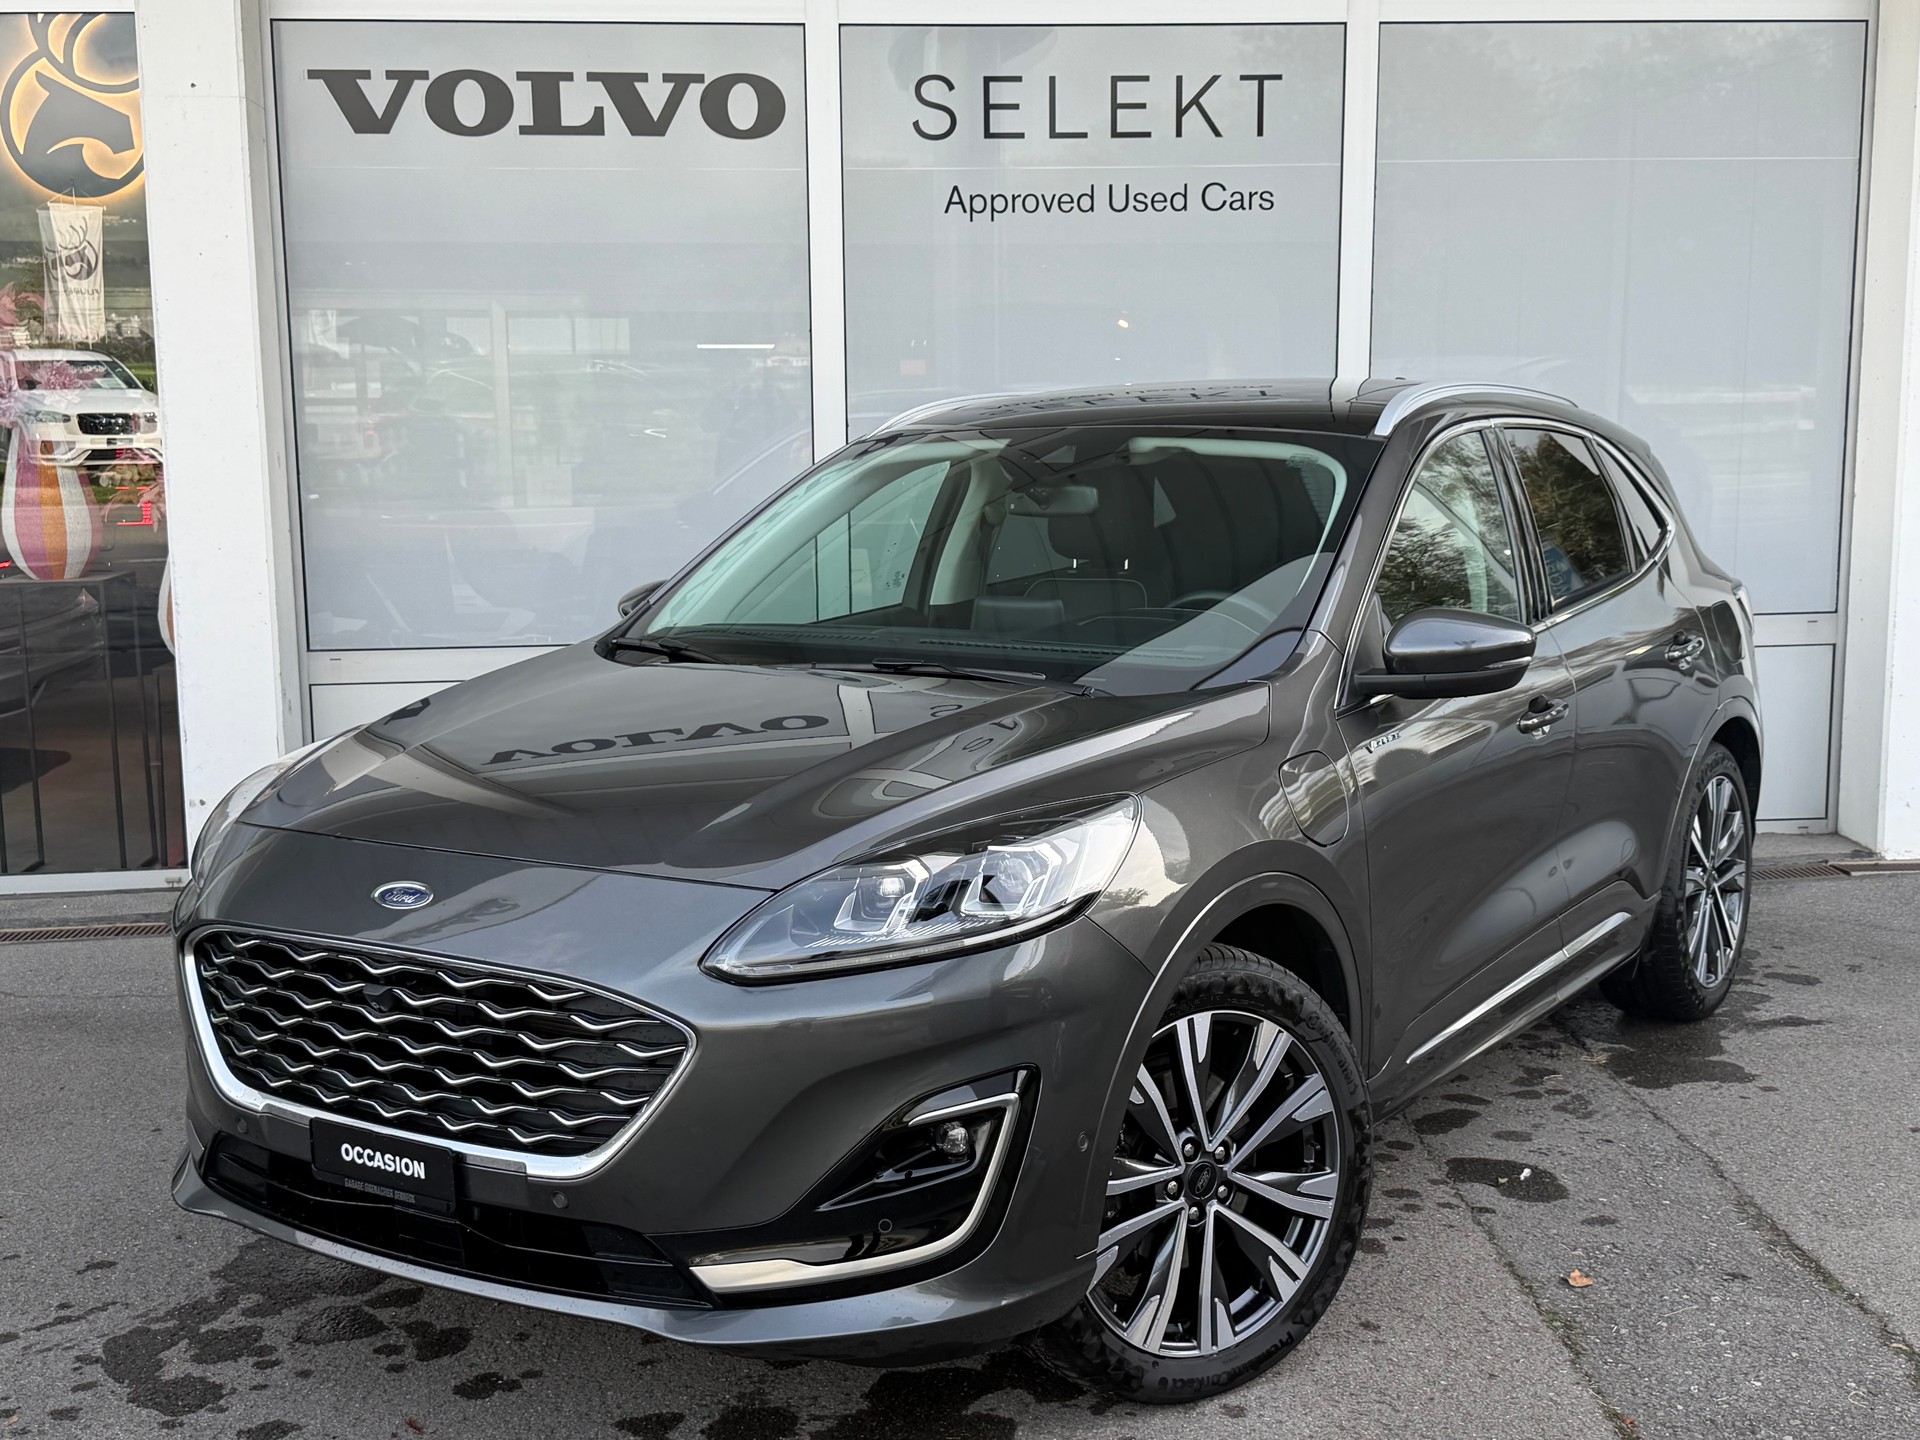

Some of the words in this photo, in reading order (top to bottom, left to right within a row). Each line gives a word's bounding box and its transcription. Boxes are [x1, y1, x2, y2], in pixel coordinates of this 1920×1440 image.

[306, 69, 786, 140] VOLVO
[912, 74, 1284, 141] SELEKT
[944, 184, 1095, 223] Approved
[1108, 183, 1188, 213] Used
[1201, 182, 1275, 212] Cars
[384, 887, 421, 904] Ford
[340, 1143, 426, 1179] OCCASION
